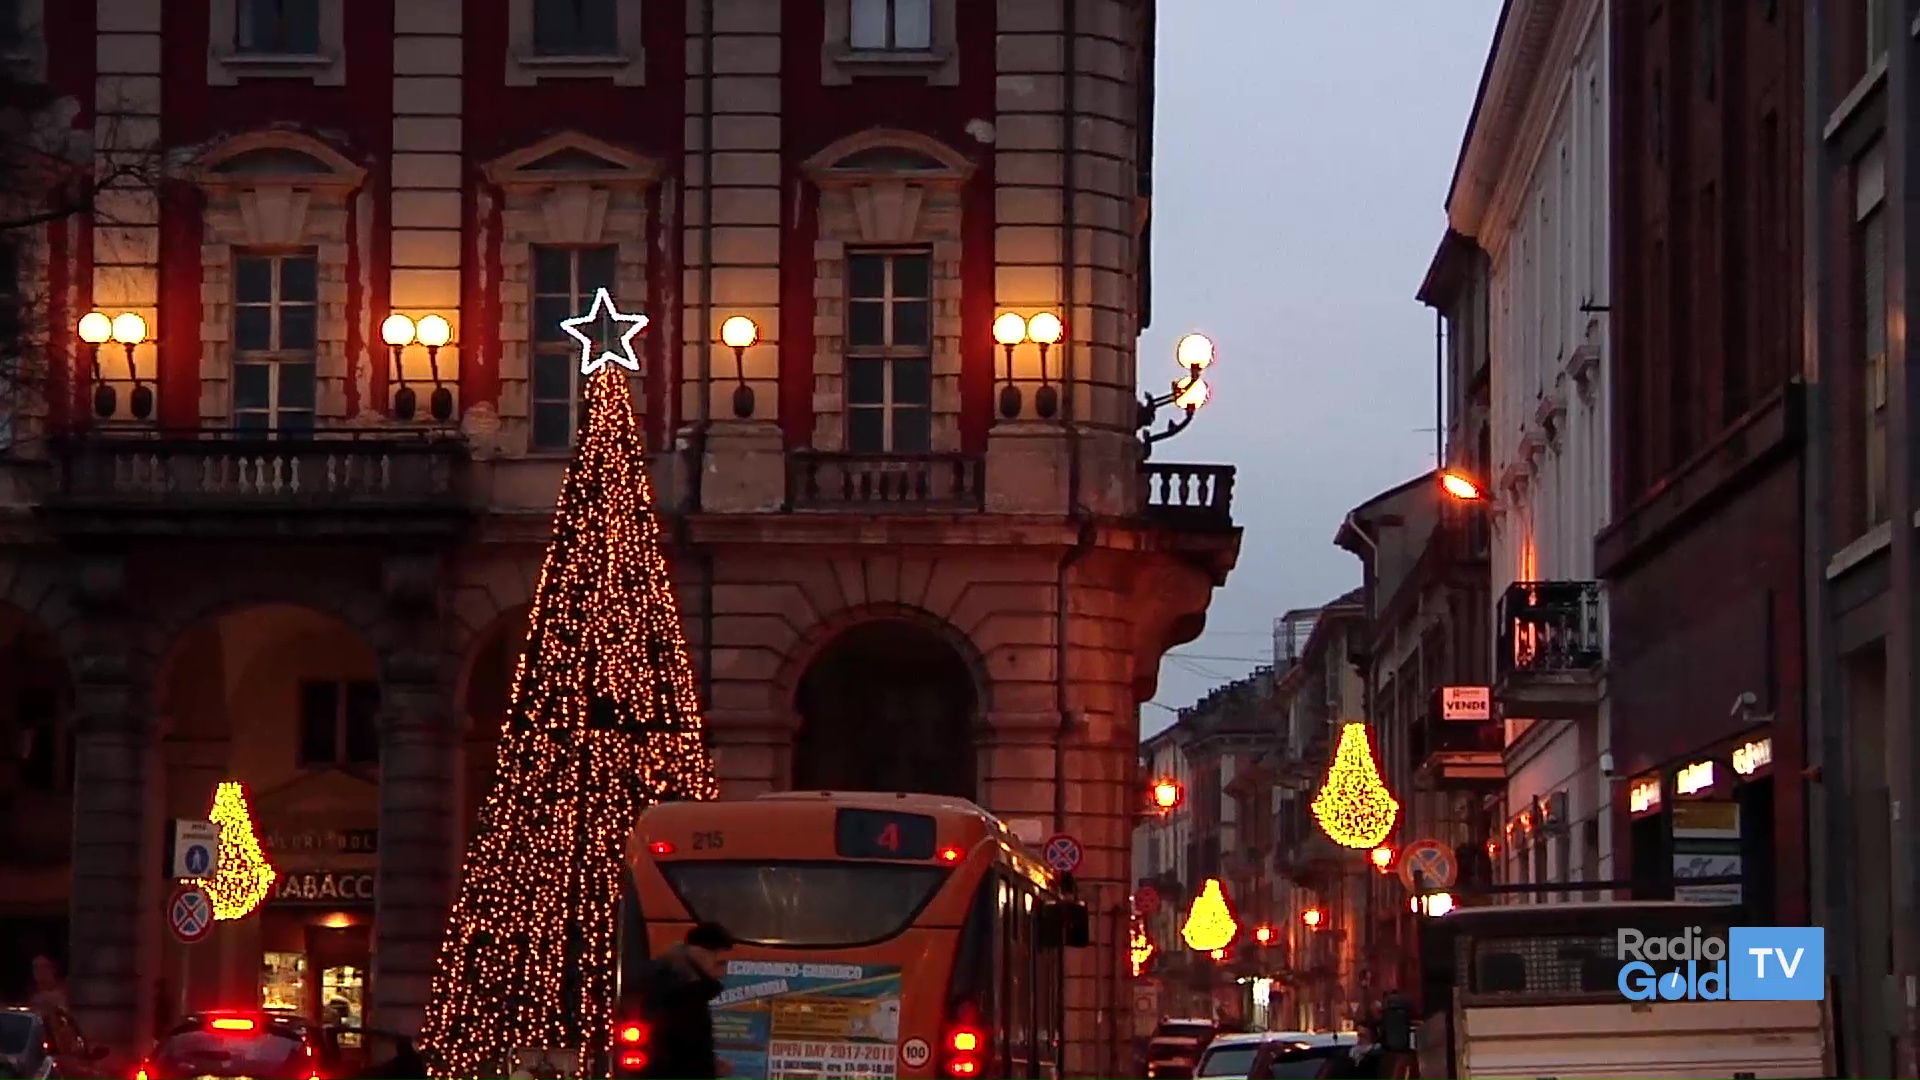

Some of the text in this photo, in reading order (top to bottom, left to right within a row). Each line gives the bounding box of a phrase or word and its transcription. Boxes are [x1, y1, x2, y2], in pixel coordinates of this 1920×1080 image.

[1446, 700, 1485, 710] VENDE
[692, 830, 724, 850] 215
[877, 822, 900, 850] 4
[906, 1046, 926, 1058] 100
